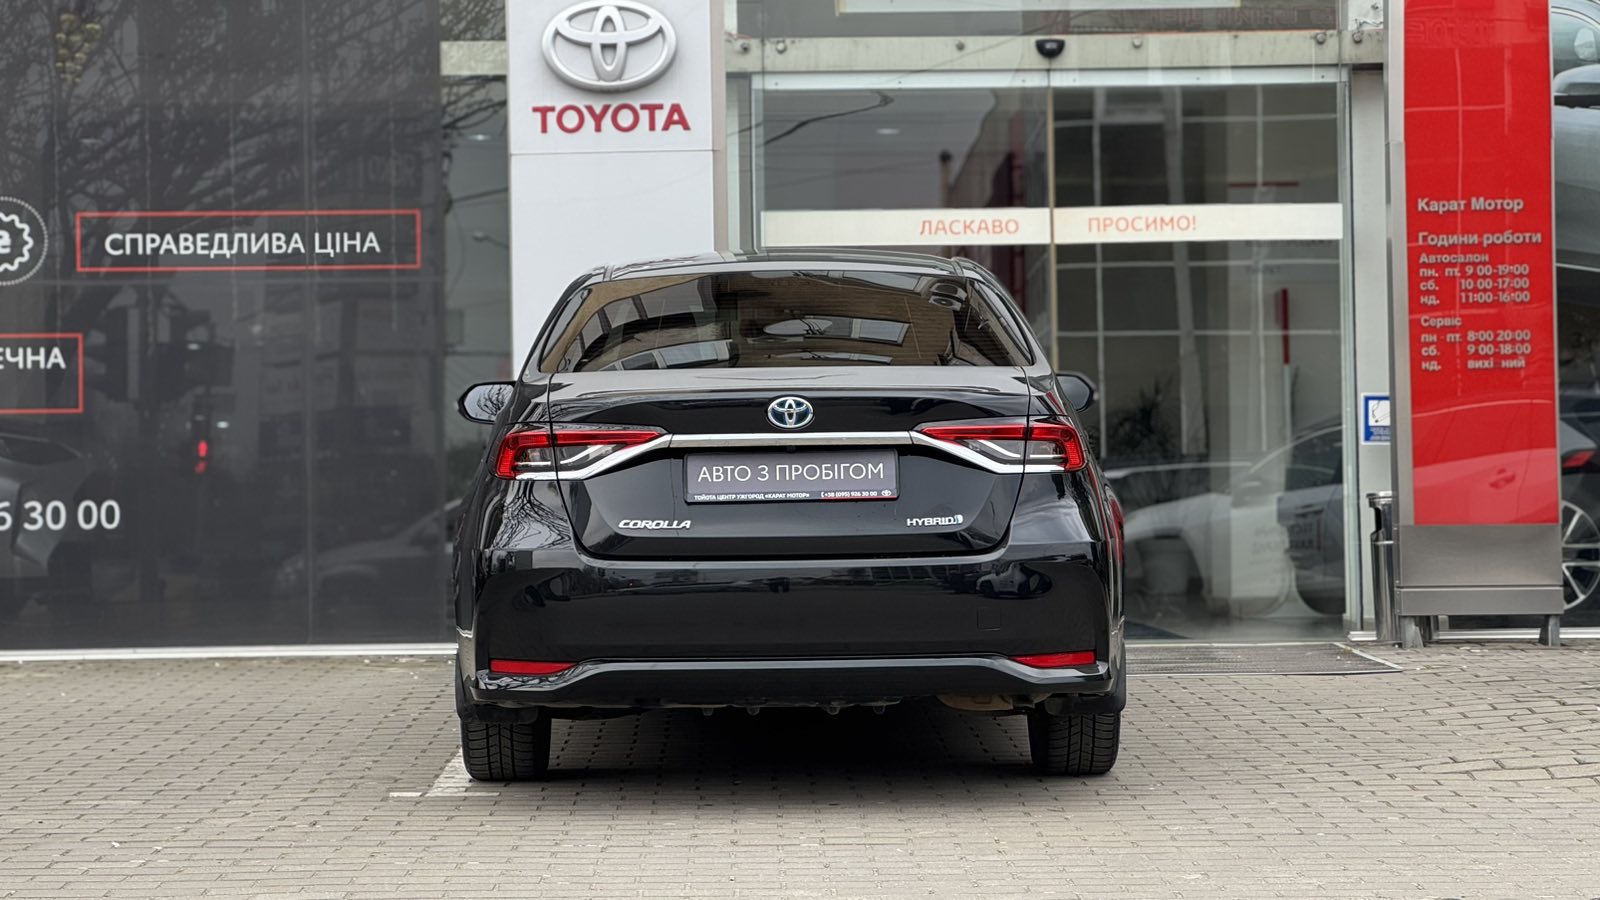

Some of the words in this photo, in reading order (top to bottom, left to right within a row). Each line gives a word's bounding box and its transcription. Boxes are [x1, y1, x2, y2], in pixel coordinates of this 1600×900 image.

[532, 103, 691, 134] TOYOTA
[1418, 198, 1466, 214] Карат
[1471, 197, 1524, 213] Мотор
[920, 219, 1020, 235] ЛАСКАВО
[1088, 215, 1197, 232] ПРОСИМО!
[104, 232, 305, 258] СПРАВЕДЛИВА
[314, 231, 381, 257] ЦІНА
[1418, 231, 1478, 247] Години
[1483, 230, 1542, 247] роботи
[1419, 253, 1489, 263] Автосалон
[1420, 280, 1439, 290] сб.
[1420, 315, 1462, 328] Сервіс
[0, 346, 66, 369] ЧНА
[698, 465, 751, 482] АВТО
[776, 463, 884, 480] ПРОБІГОМ
[23, 500, 67, 531] 30
[77, 500, 120, 530] 00
[906, 516, 955, 527] HYBRID
[618, 519, 692, 530] COROLLA
